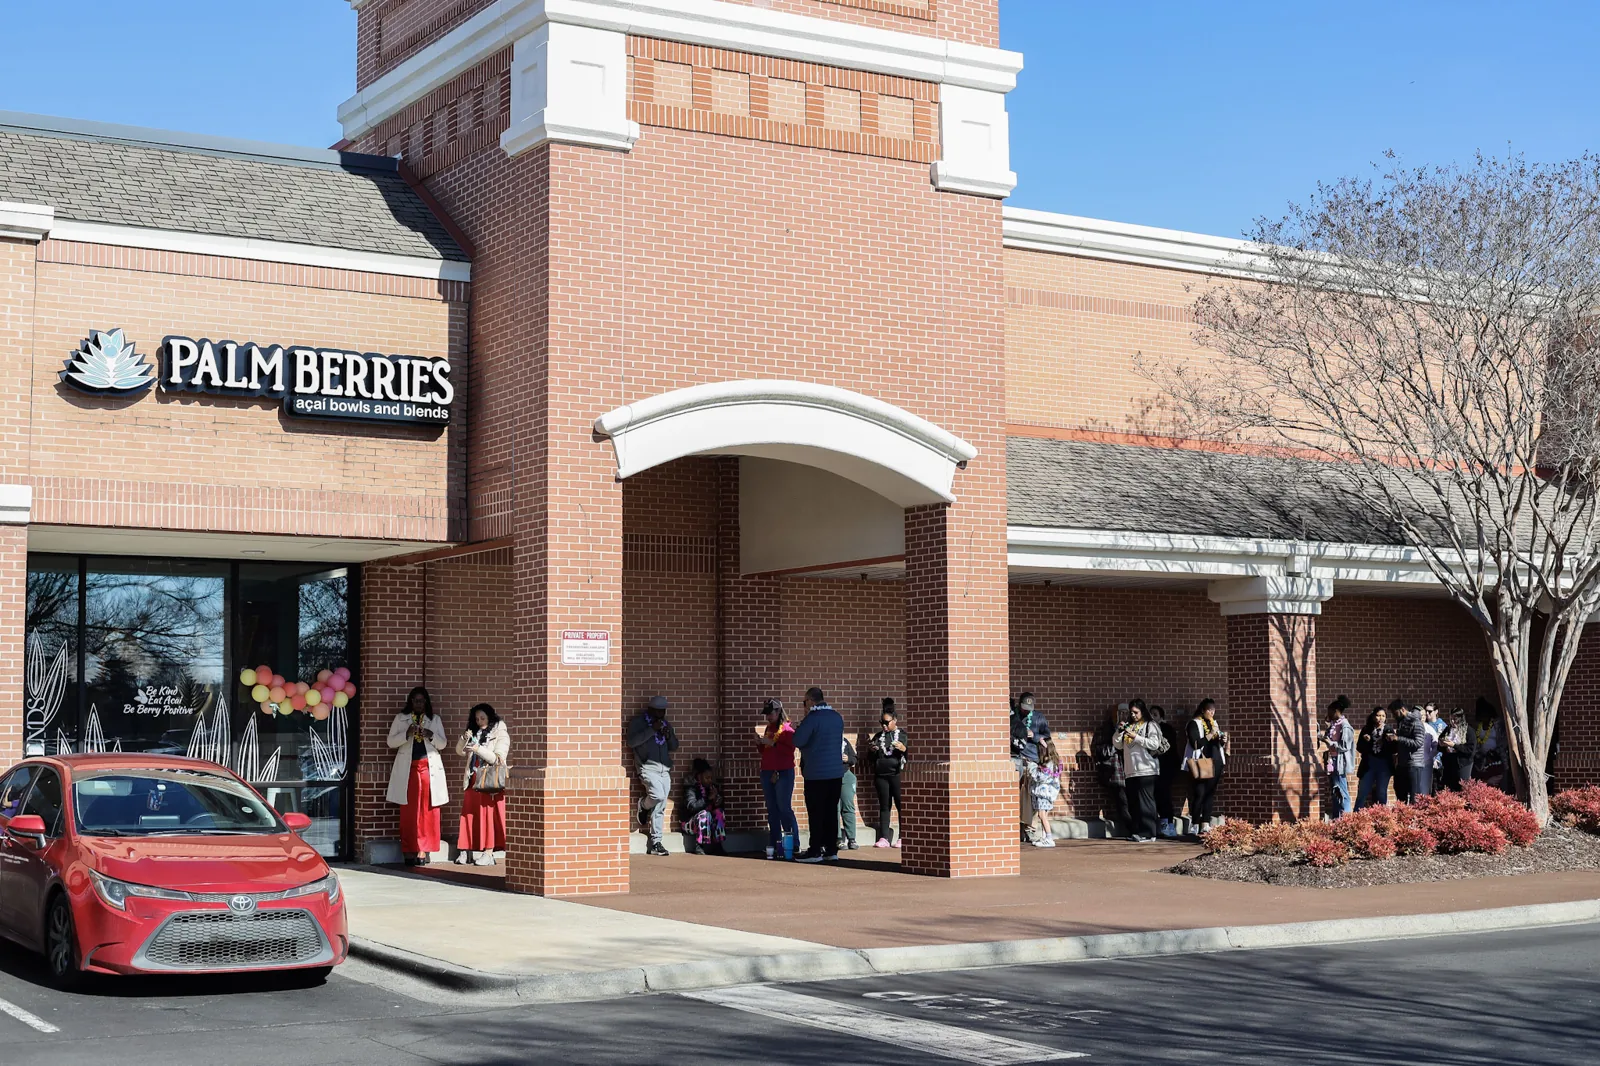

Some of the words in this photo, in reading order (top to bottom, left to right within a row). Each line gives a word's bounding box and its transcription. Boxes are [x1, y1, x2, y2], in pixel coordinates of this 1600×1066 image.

[169, 339, 285, 391] PALM
[294, 350, 454, 405] BERRIES
[295, 398, 327, 412] açaí
[330, 399, 371, 414] bowls
[374, 403, 400, 416] and
[403, 404, 449, 419] blends
[565, 631, 584, 639] PRIVATE
[146, 685, 157, 696] Be
[158, 685, 178, 696] Kind
[147, 695, 163, 705] Eat
[123, 703, 135, 714] Be
[136, 704, 161, 717] Berry
[162, 705, 194, 715] Positive
